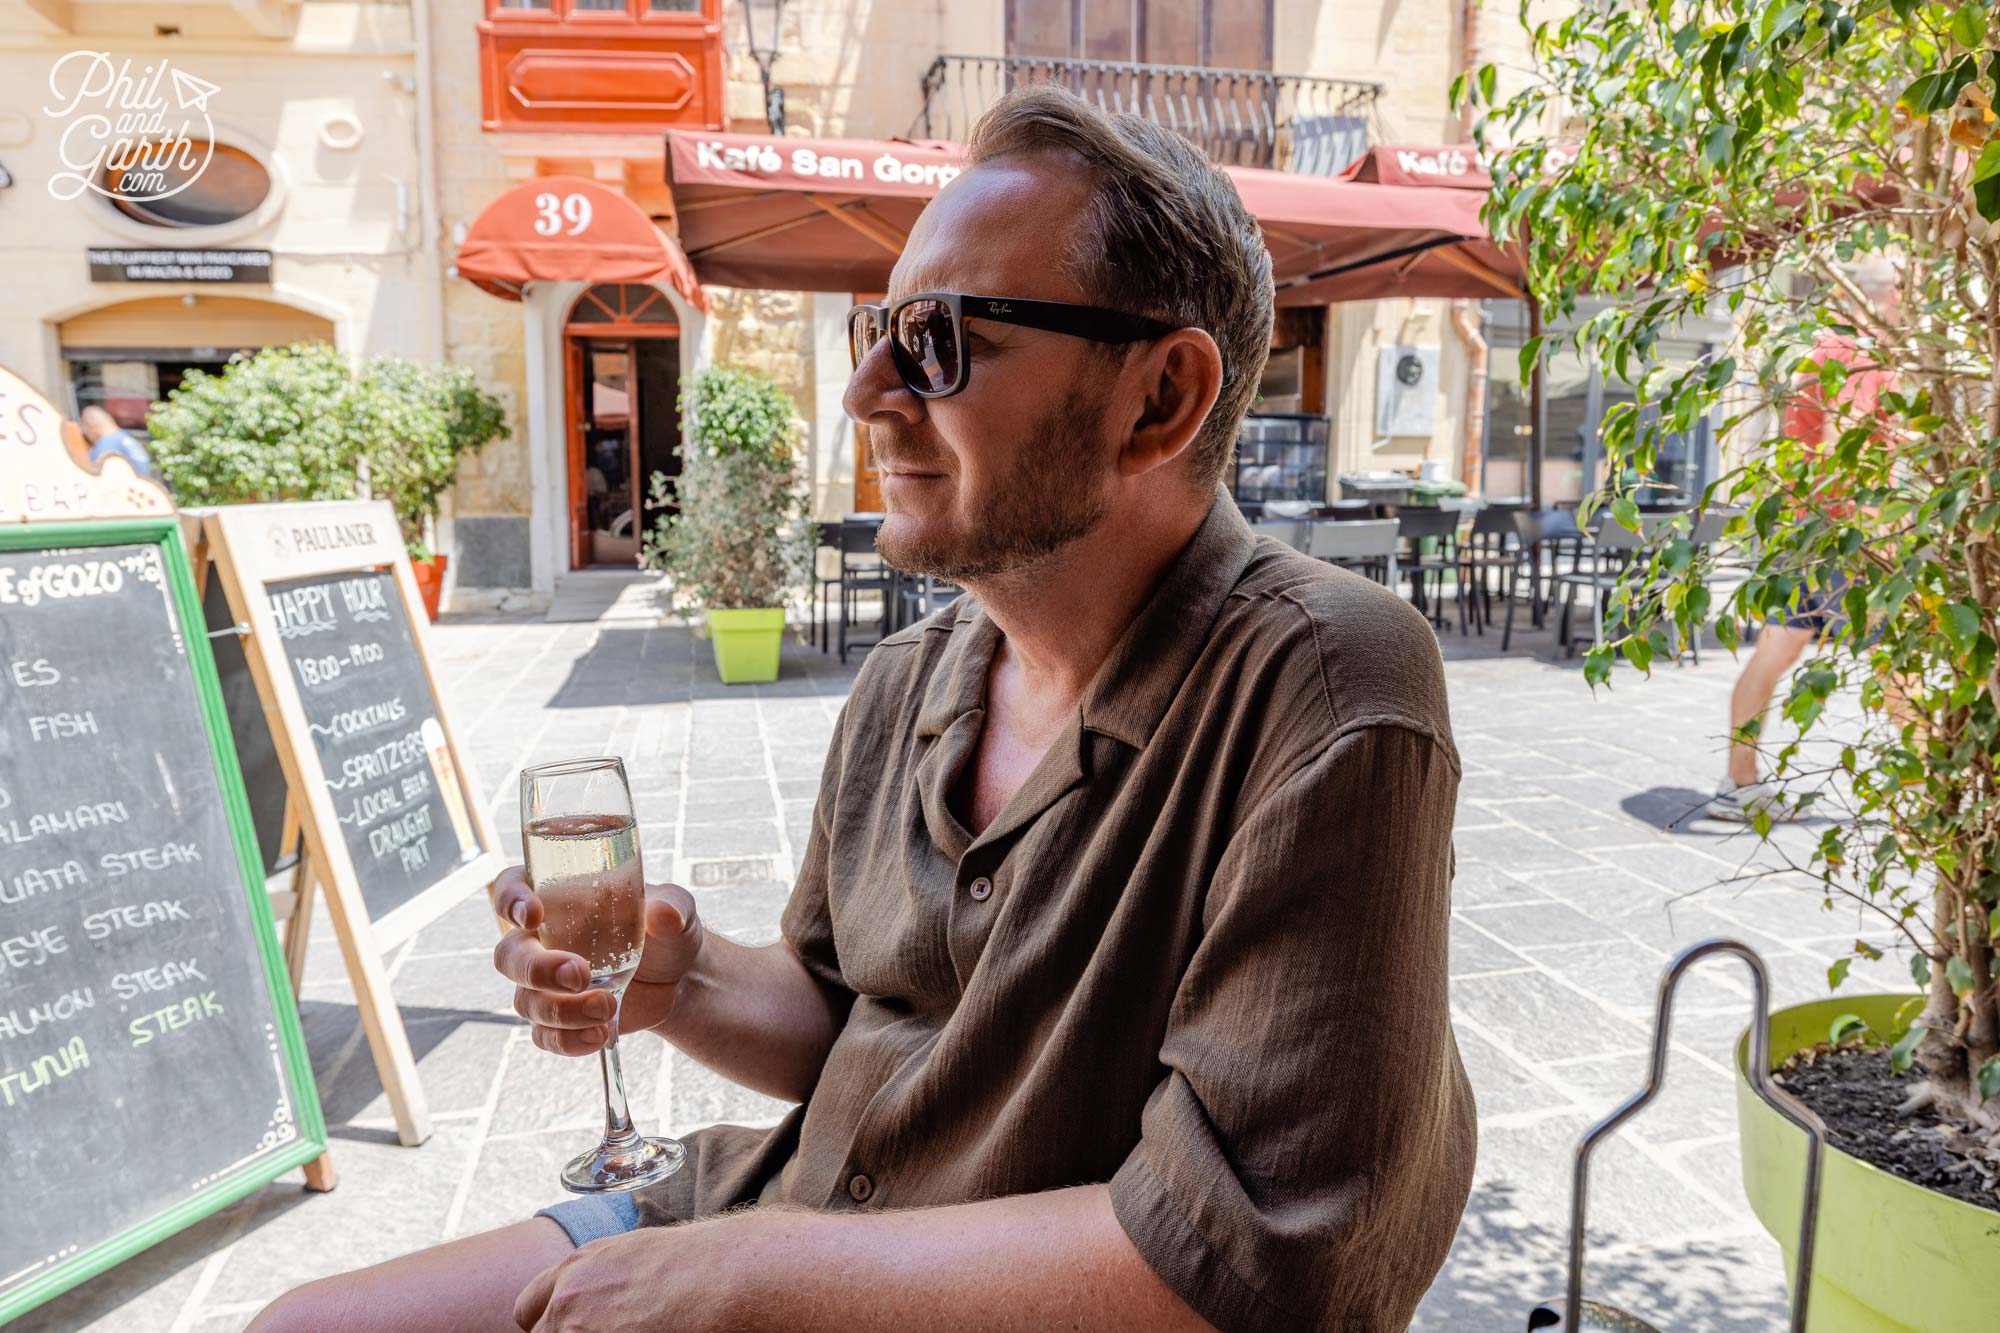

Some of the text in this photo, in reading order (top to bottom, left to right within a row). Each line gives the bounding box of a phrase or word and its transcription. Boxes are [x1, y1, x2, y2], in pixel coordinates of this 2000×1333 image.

[792, 148, 863, 180] San
[534, 193, 592, 236] 39
[292, 523, 376, 553] PAULANER
[42, 560, 123, 599] GOZO
[271, 578, 387, 629] HAPPY HOUR
[29, 711, 99, 741] FISH
[342, 730, 426, 788] SPRITZERS
[353, 786, 402, 826] LOCAL
[100, 842, 203, 877] STEAK
[83, 899, 191, 940] STEAK
[111, 957, 208, 1000] STEAK
[0, 990, 225, 1106] TUNA STEAK
